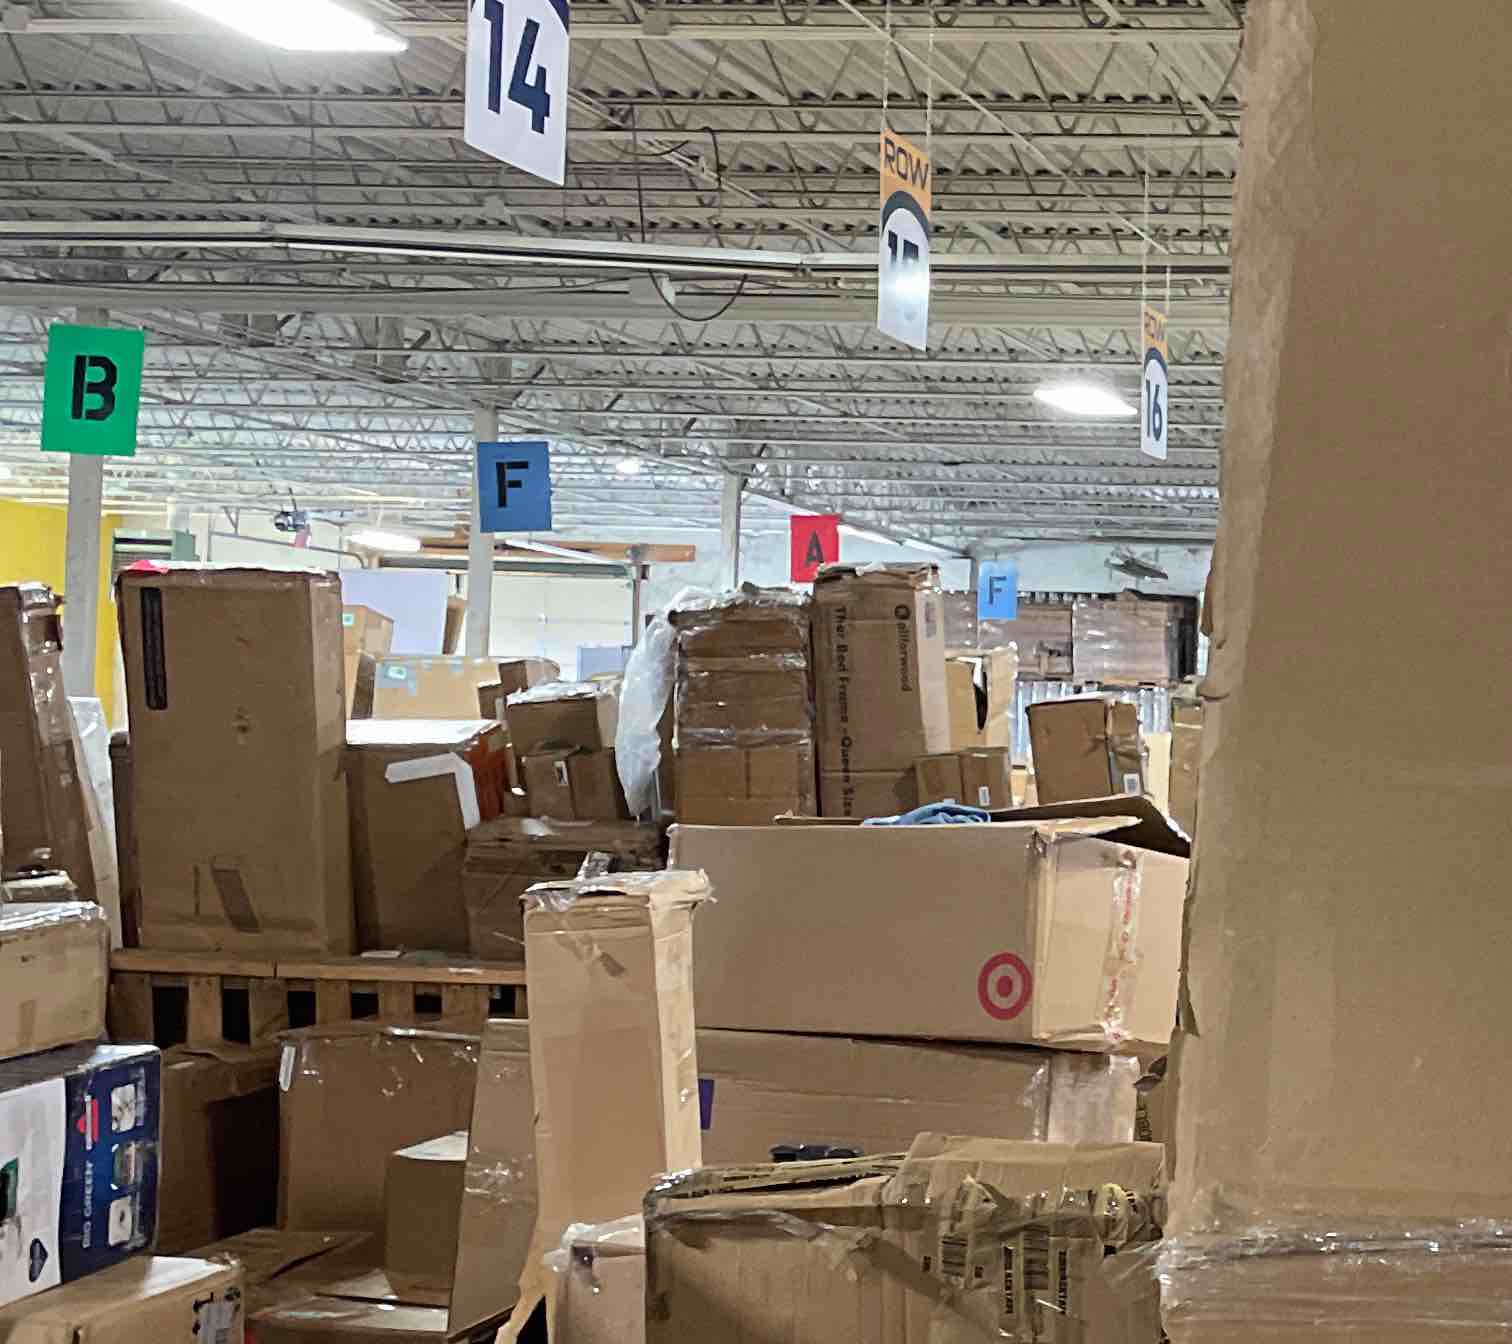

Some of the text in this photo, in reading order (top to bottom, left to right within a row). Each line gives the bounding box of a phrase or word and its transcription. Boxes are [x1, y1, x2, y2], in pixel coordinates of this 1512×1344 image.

[884, 138, 928, 189] ROW
[71, 354, 117, 421] B
[1146, 379, 1162, 442] 16
[496, 460, 529, 509] F
[804, 531, 825, 567] A
[988, 575, 1007, 606] F
